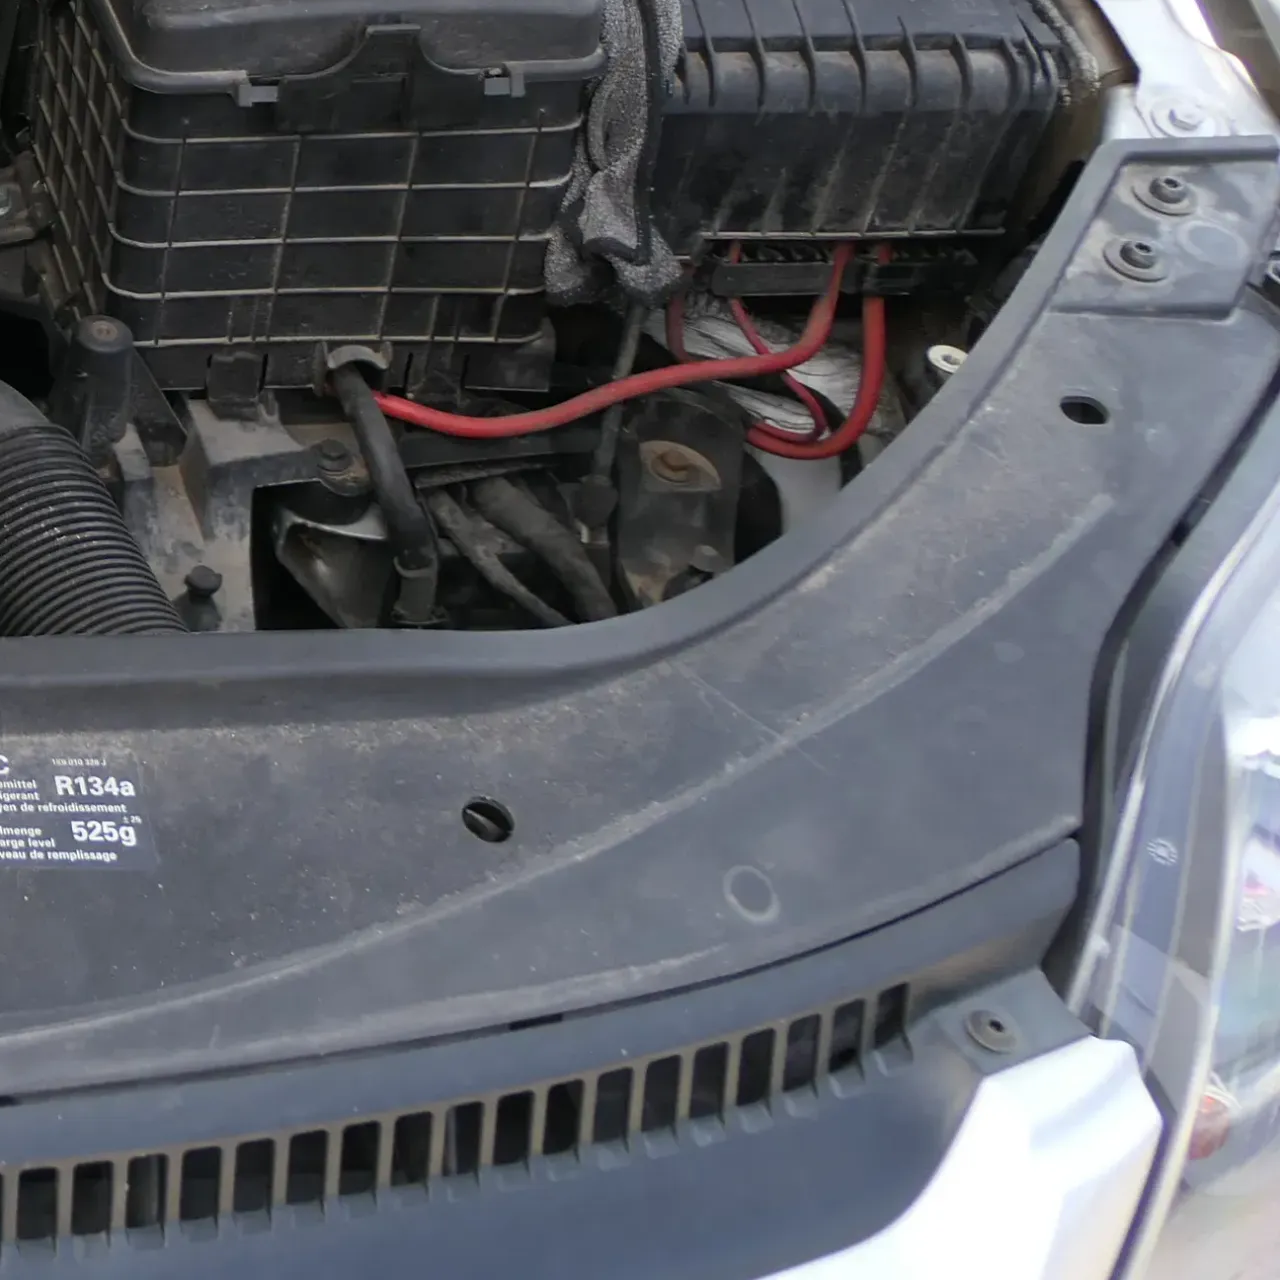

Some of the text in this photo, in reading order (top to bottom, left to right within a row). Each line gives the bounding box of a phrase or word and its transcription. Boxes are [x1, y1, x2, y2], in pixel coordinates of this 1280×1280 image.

[53, 775, 136, 796] R134a
[20, 802, 35, 812] de
[38, 802, 127, 813] refroidissement
[71, 820, 137, 847] 525g
[28, 837, 56, 848] level
[29, 849, 44, 859] de
[47, 850, 117, 862] remplissage
